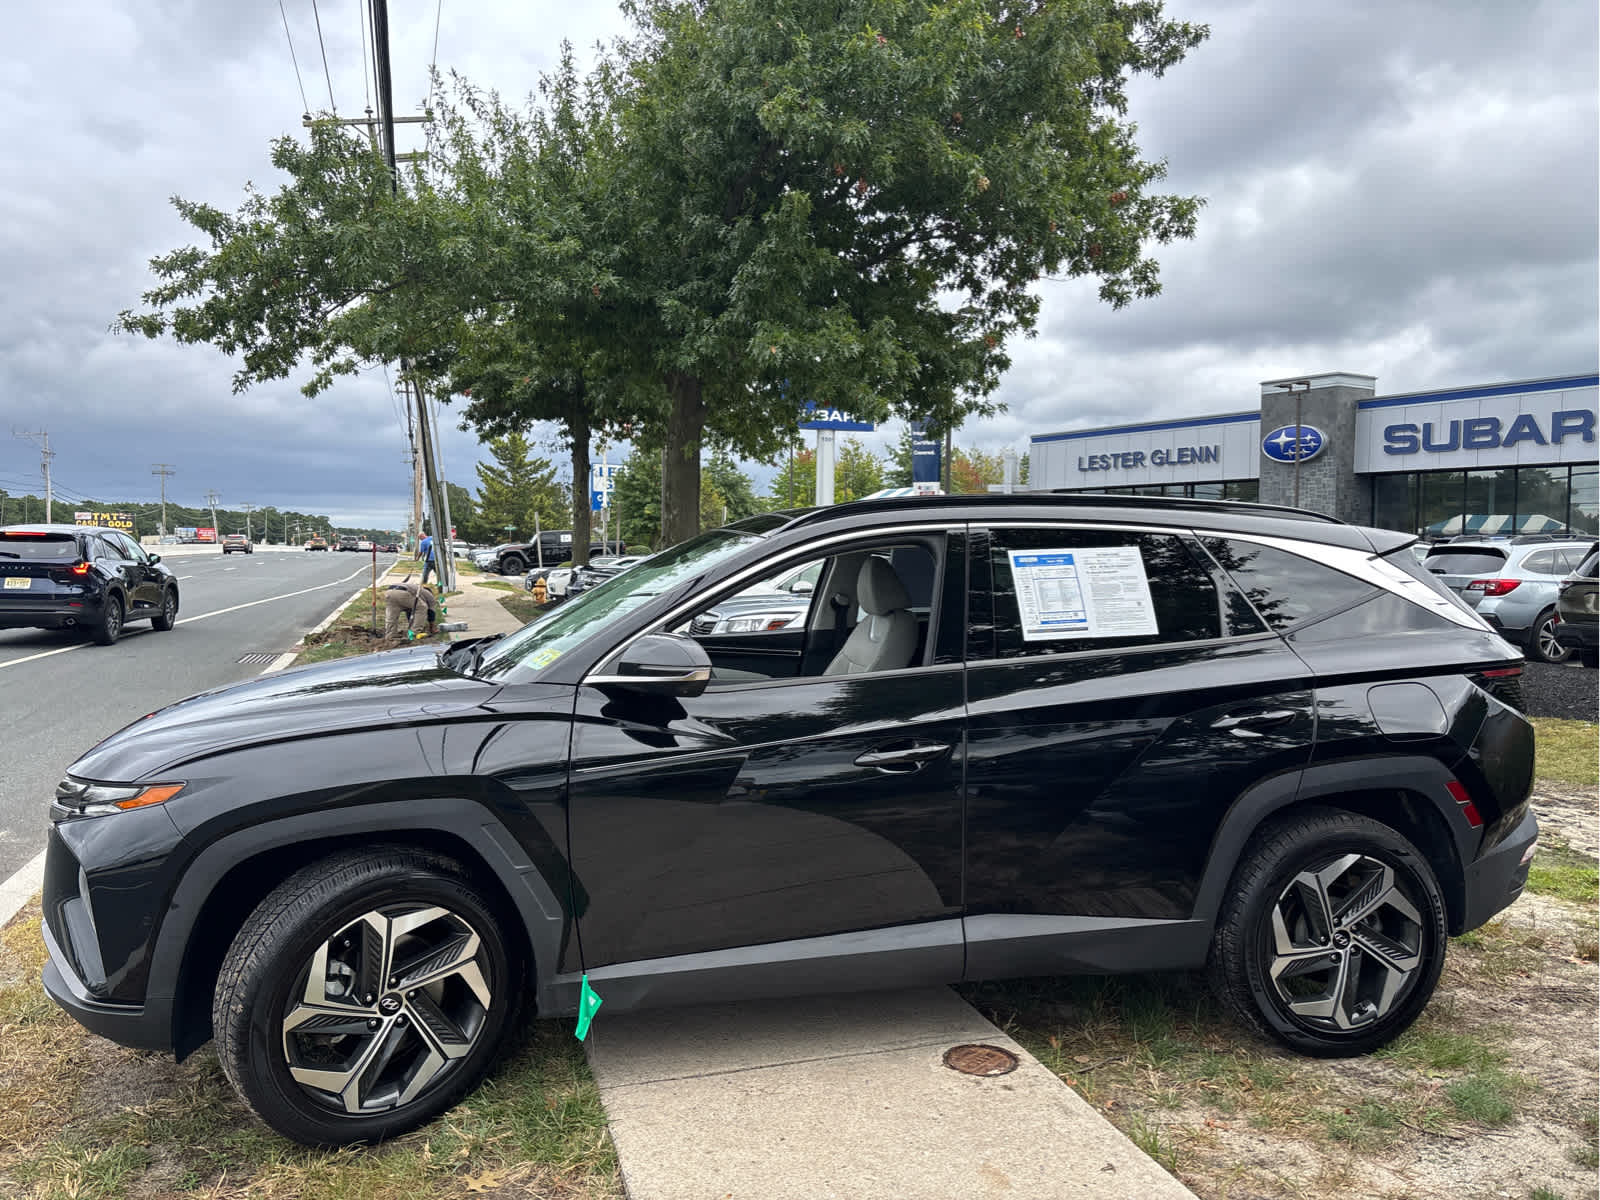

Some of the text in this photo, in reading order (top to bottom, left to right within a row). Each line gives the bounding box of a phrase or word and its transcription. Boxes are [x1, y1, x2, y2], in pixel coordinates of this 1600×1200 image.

[1383, 409, 1595, 456] SUBAR
[1078, 445, 1219, 472] LESTER GLENN
[92, 512, 118, 520] TMT
[108, 520, 133, 528] GOLD
